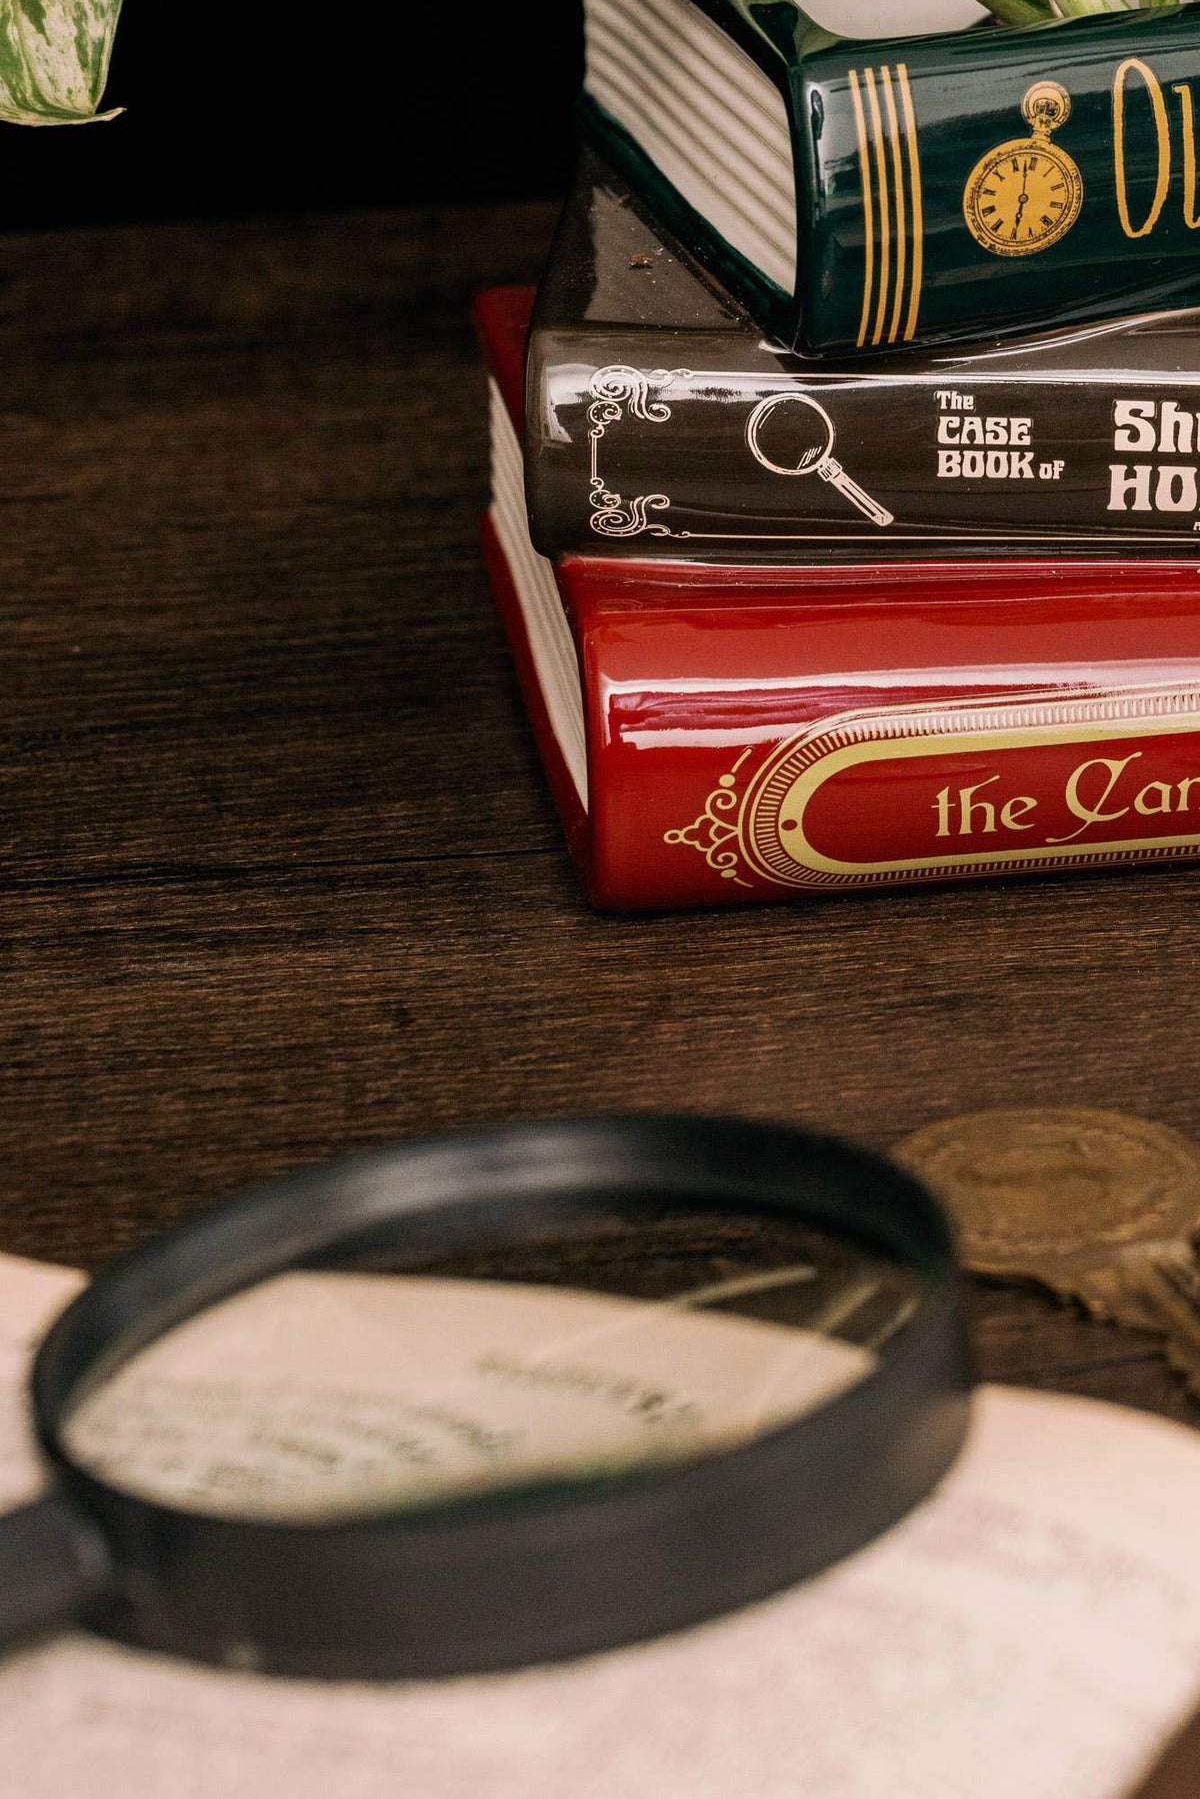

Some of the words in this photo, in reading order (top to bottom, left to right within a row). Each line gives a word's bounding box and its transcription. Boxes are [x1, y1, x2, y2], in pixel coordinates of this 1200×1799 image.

[934, 390, 974, 411] The
[937, 415, 1032, 446] CASE
[936, 450, 1035, 479] BOOK
[931, 774, 1038, 837] the
